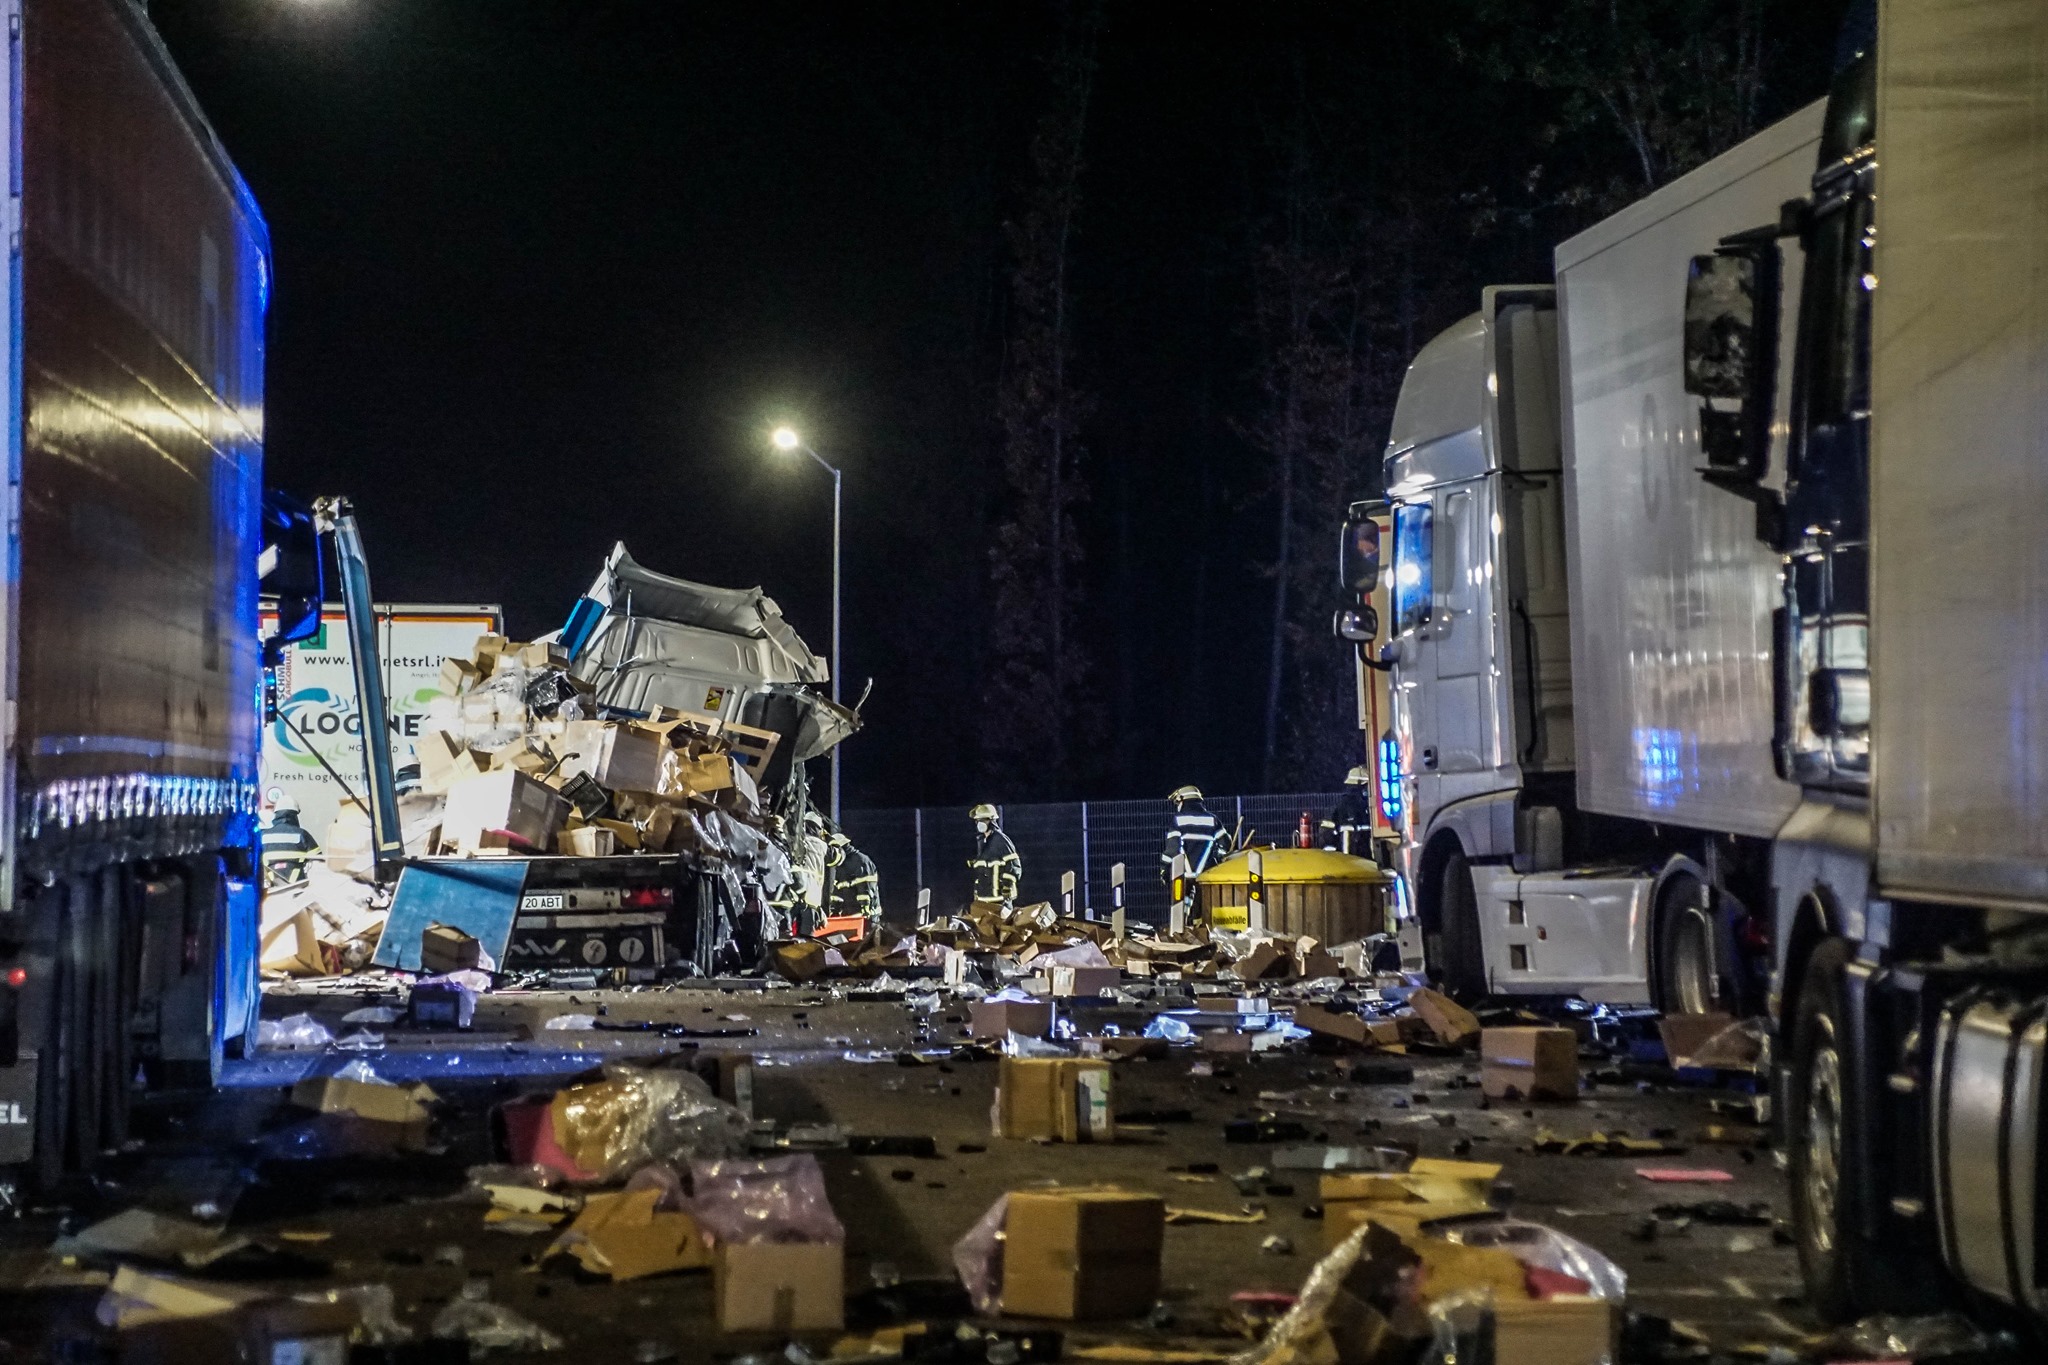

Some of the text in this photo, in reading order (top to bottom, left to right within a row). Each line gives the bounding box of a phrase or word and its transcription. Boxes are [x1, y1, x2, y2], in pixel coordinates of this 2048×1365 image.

[273, 773, 304, 781] Fresh
[525, 897, 560, 908] 20 ABT
